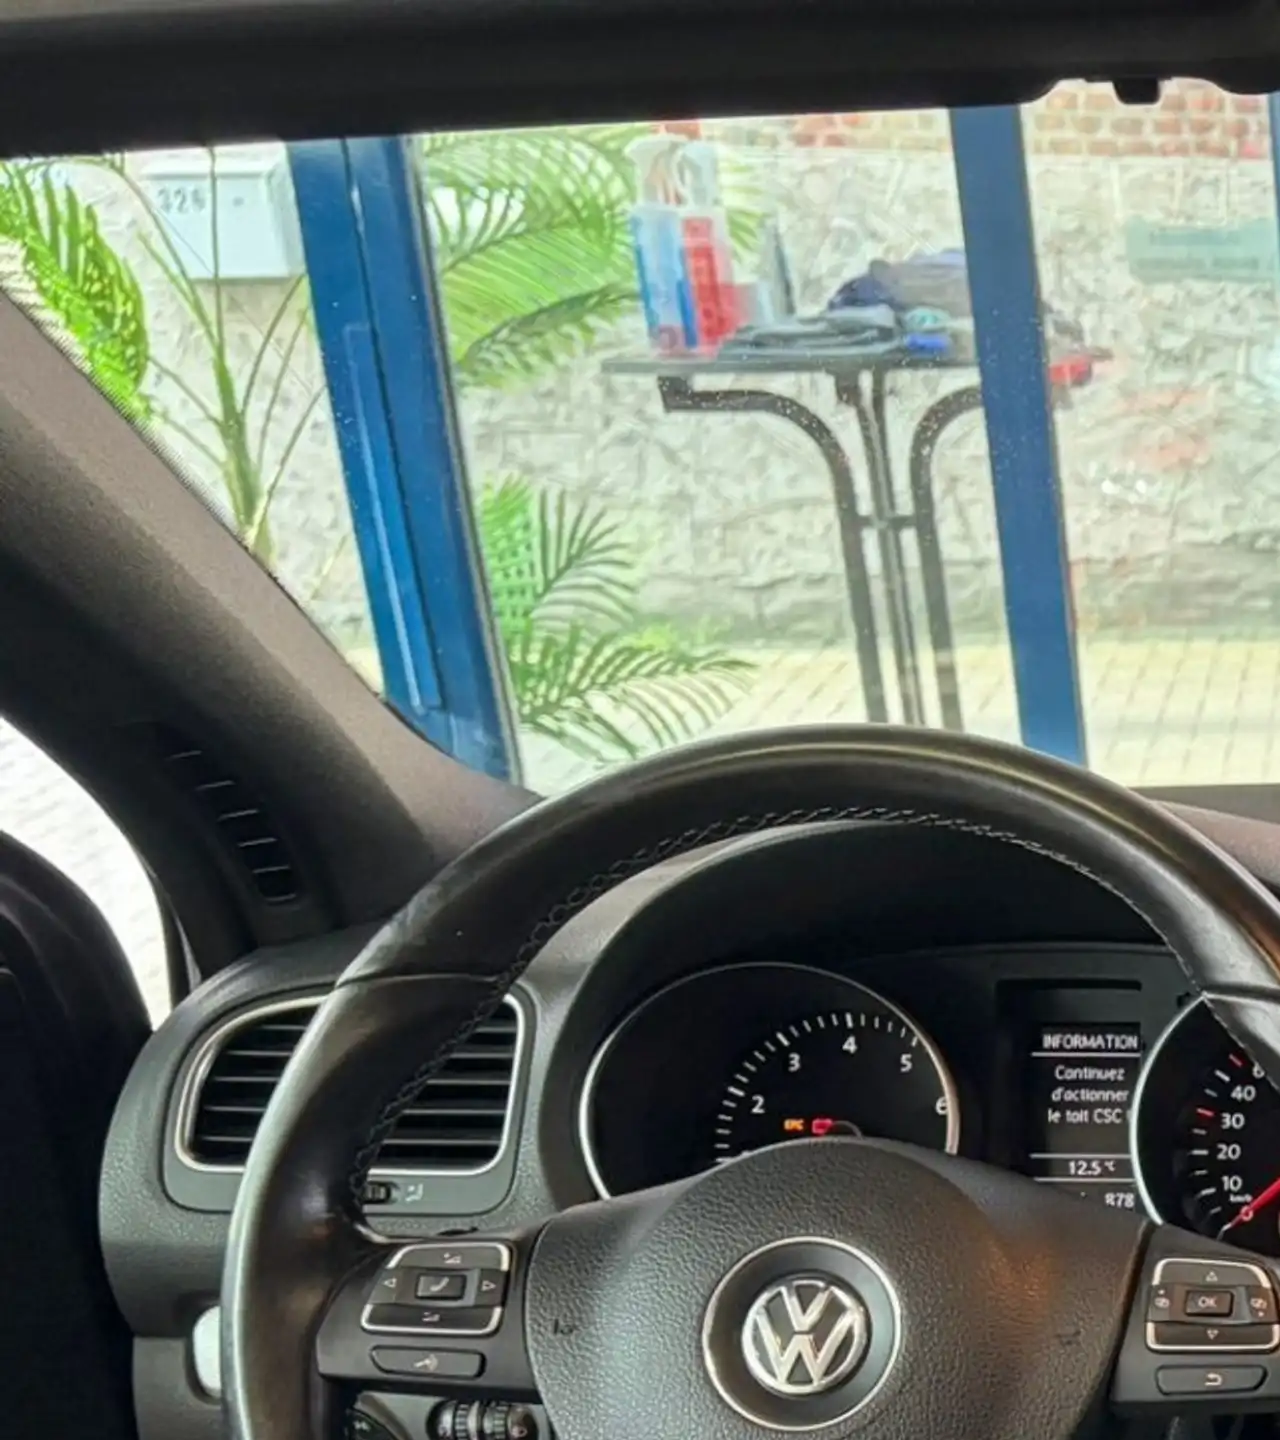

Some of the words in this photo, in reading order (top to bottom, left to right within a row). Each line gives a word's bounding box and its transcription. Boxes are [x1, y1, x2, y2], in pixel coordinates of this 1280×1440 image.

[842, 1036, 857, 1054] 4
[1042, 1034, 1138, 1050] INFORMATION
[788, 1053, 801, 1072] 3
[900, 1054, 913, 1073] 5
[1054, 1065, 1126, 1081] Continuez
[1051, 1086, 1129, 1101] d'actionner
[1230, 1085, 1256, 1101] 40
[751, 1095, 765, 1113] 2
[1048, 1109, 1062, 1124] le
[1066, 1109, 1090, 1124] toit
[1093, 1109, 1123, 1124] CSC
[1221, 1113, 1245, 1129] 30
[1216, 1144, 1241, 1160] 20
[1068, 1160, 1101, 1176] 12.5
[1221, 1175, 1243, 1191] 10
[1197, 1296, 1218, 1308] OK
[746, 1283, 863, 1390] VW
